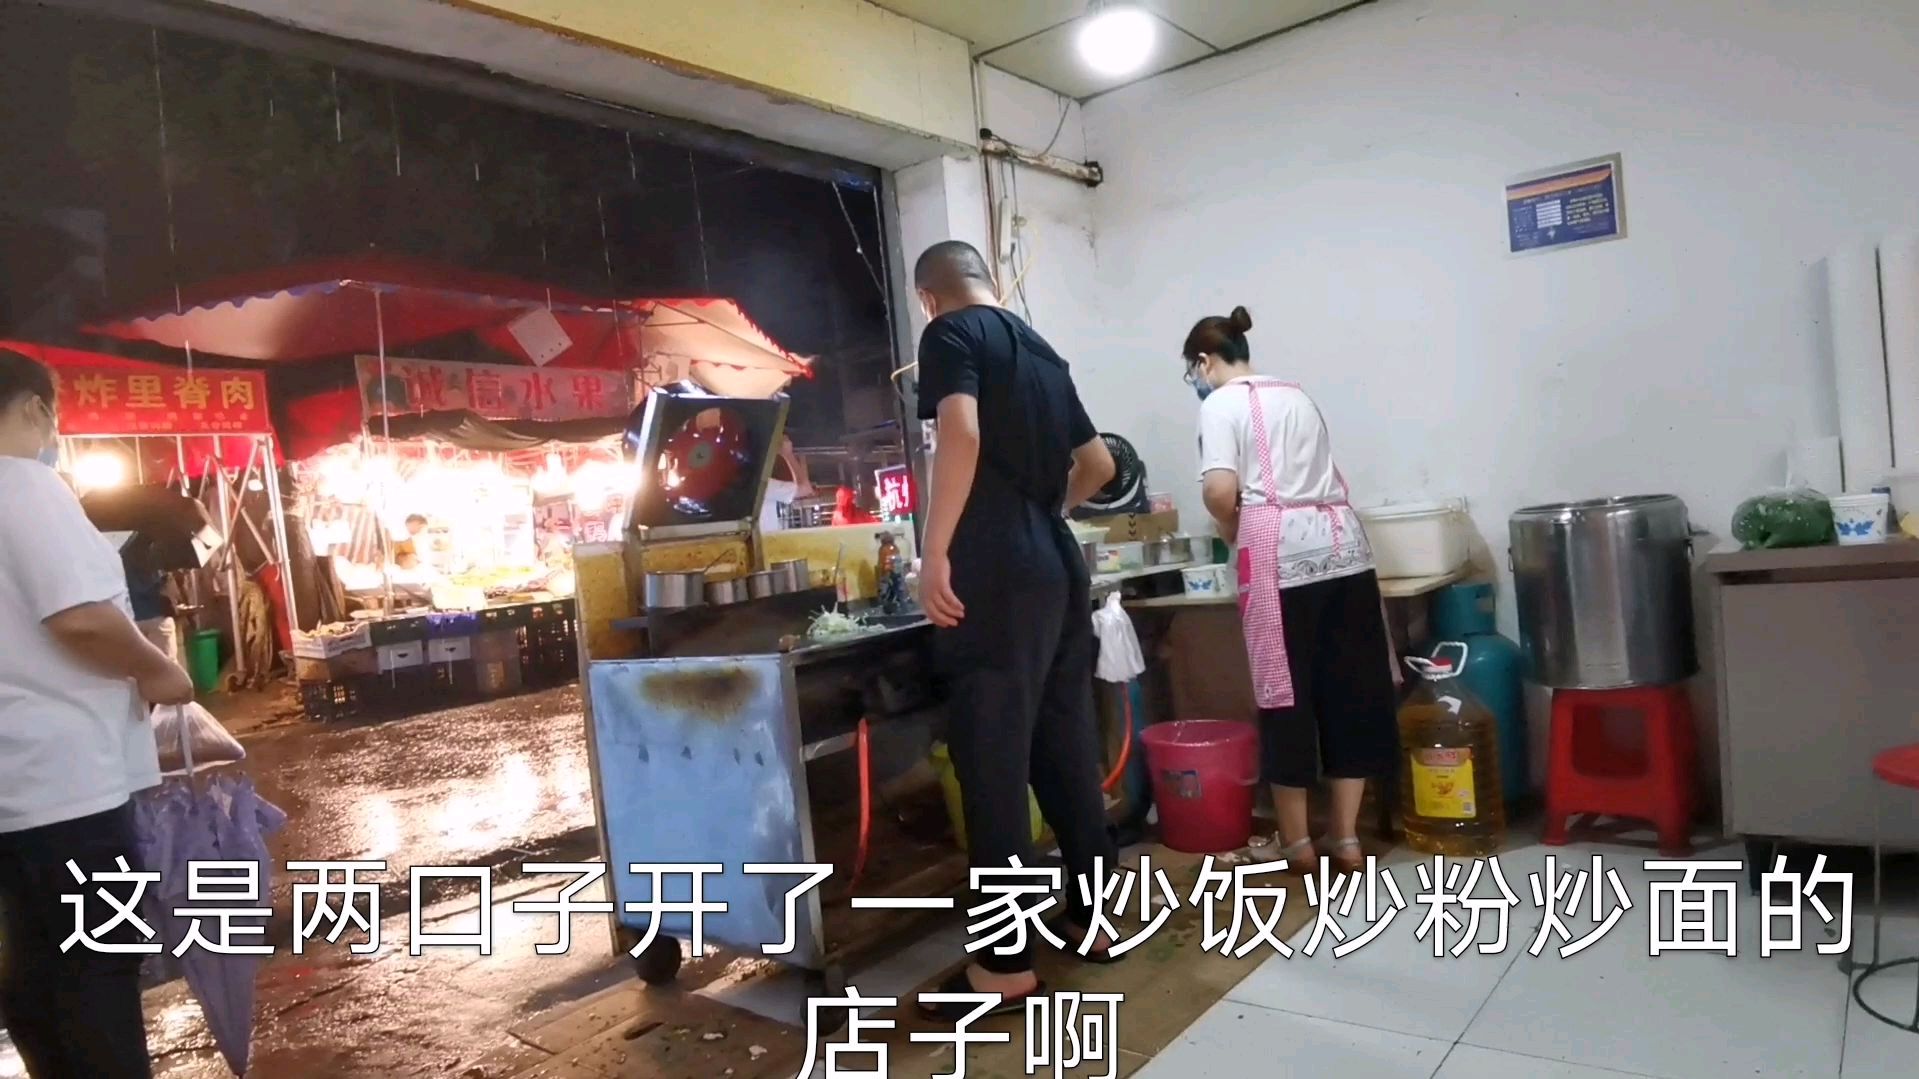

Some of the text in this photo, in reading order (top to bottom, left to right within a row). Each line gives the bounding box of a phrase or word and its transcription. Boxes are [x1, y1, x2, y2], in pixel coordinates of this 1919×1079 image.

[58, 374, 255, 410] 炸里脊肉
[403, 364, 606, 411] 诚信水果
